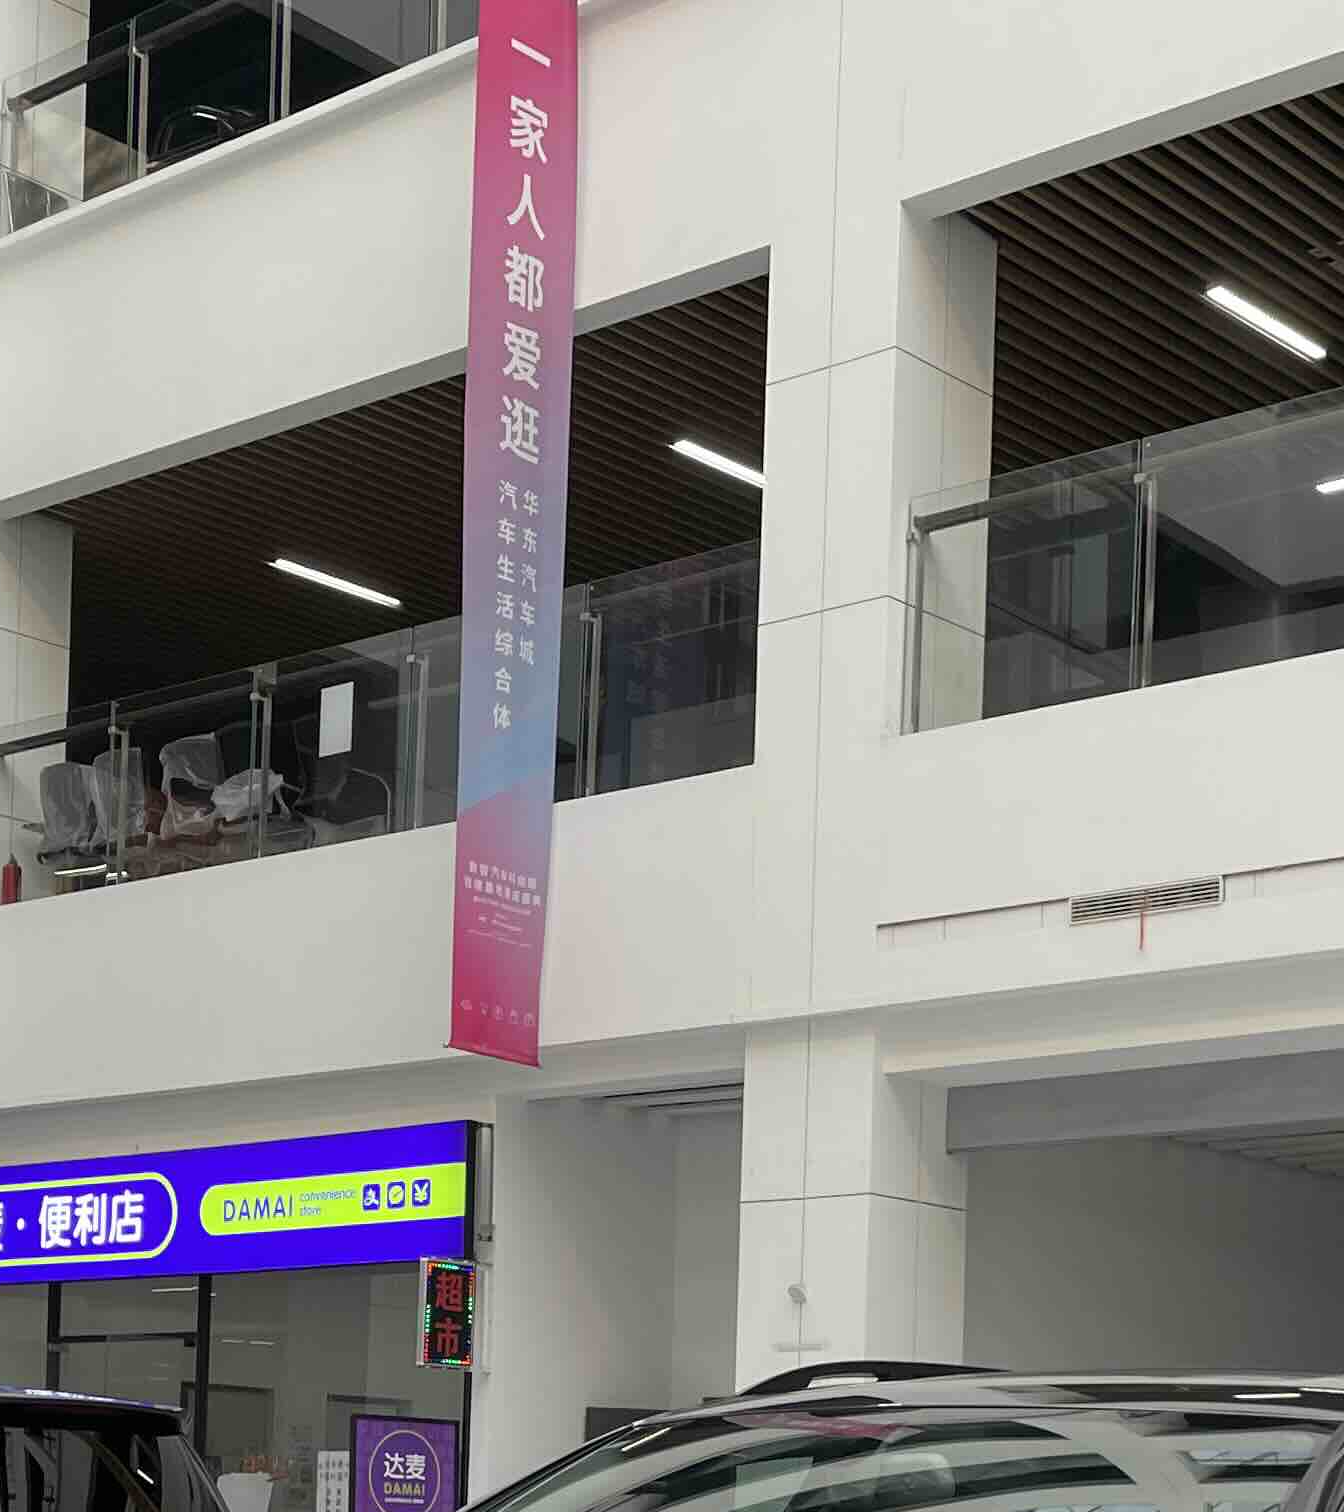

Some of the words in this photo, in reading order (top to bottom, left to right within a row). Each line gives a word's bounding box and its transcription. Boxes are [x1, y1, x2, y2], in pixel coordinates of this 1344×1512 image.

[500, 37, 551, 465] 一家人都爱逛
[492, 480, 518, 729] 汽车生活综合体
[519, 489, 539, 665] 华东汽车城
[223, 1195, 294, 1222] DAMAI
[435, 1271, 464, 1356] 超市
[384, 1452, 426, 1480] 达麦
[384, 1481, 425, 1497] DAMAI
